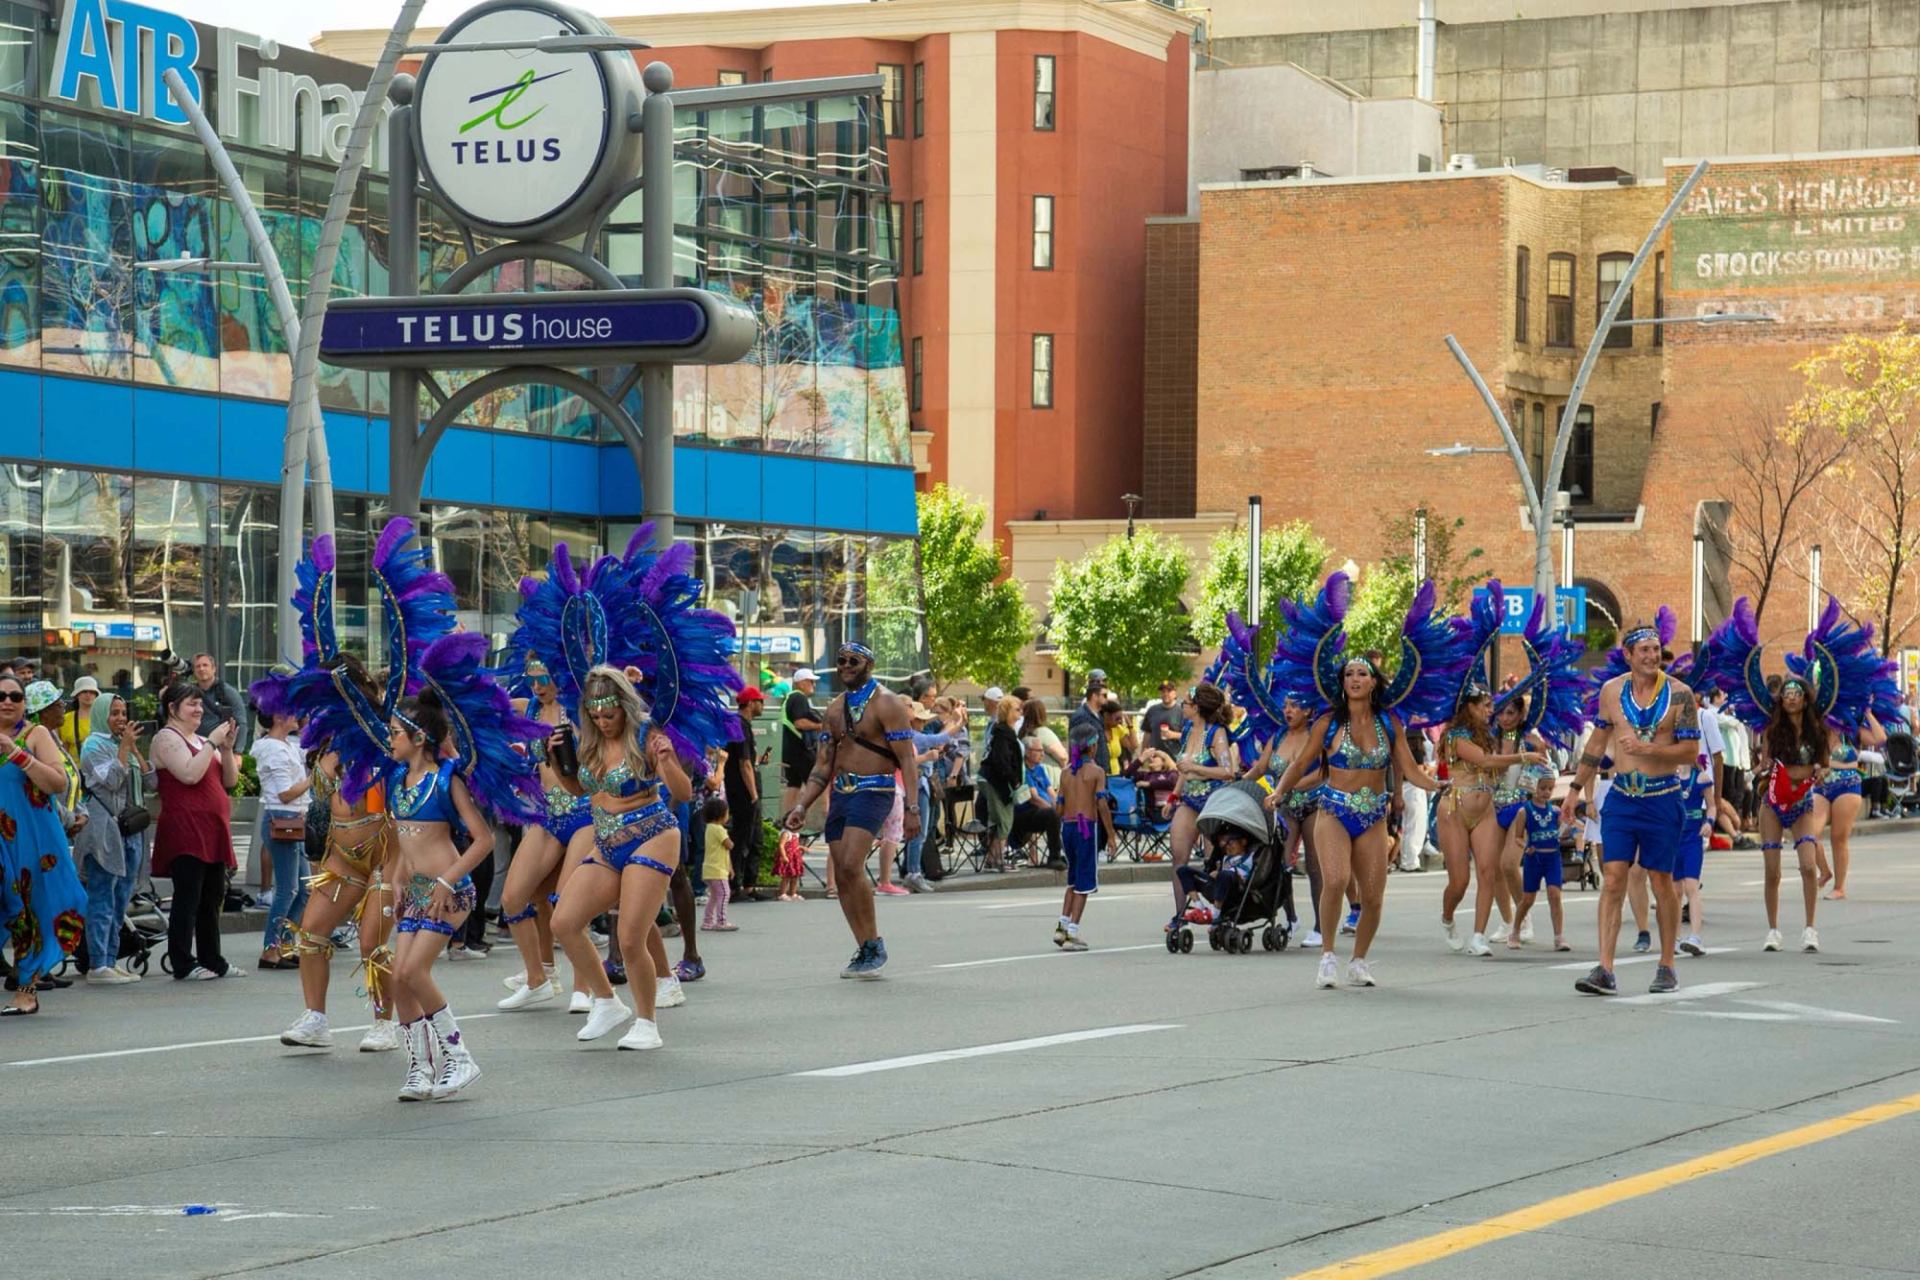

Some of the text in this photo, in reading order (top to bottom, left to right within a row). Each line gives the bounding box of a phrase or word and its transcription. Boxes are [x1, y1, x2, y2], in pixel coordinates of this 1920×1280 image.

[57, 0, 201, 125] ATB
[451, 138, 561, 164] TELUS
[1793, 215, 1906, 235] LIMITED
[397, 313, 612, 343] TELUS house
